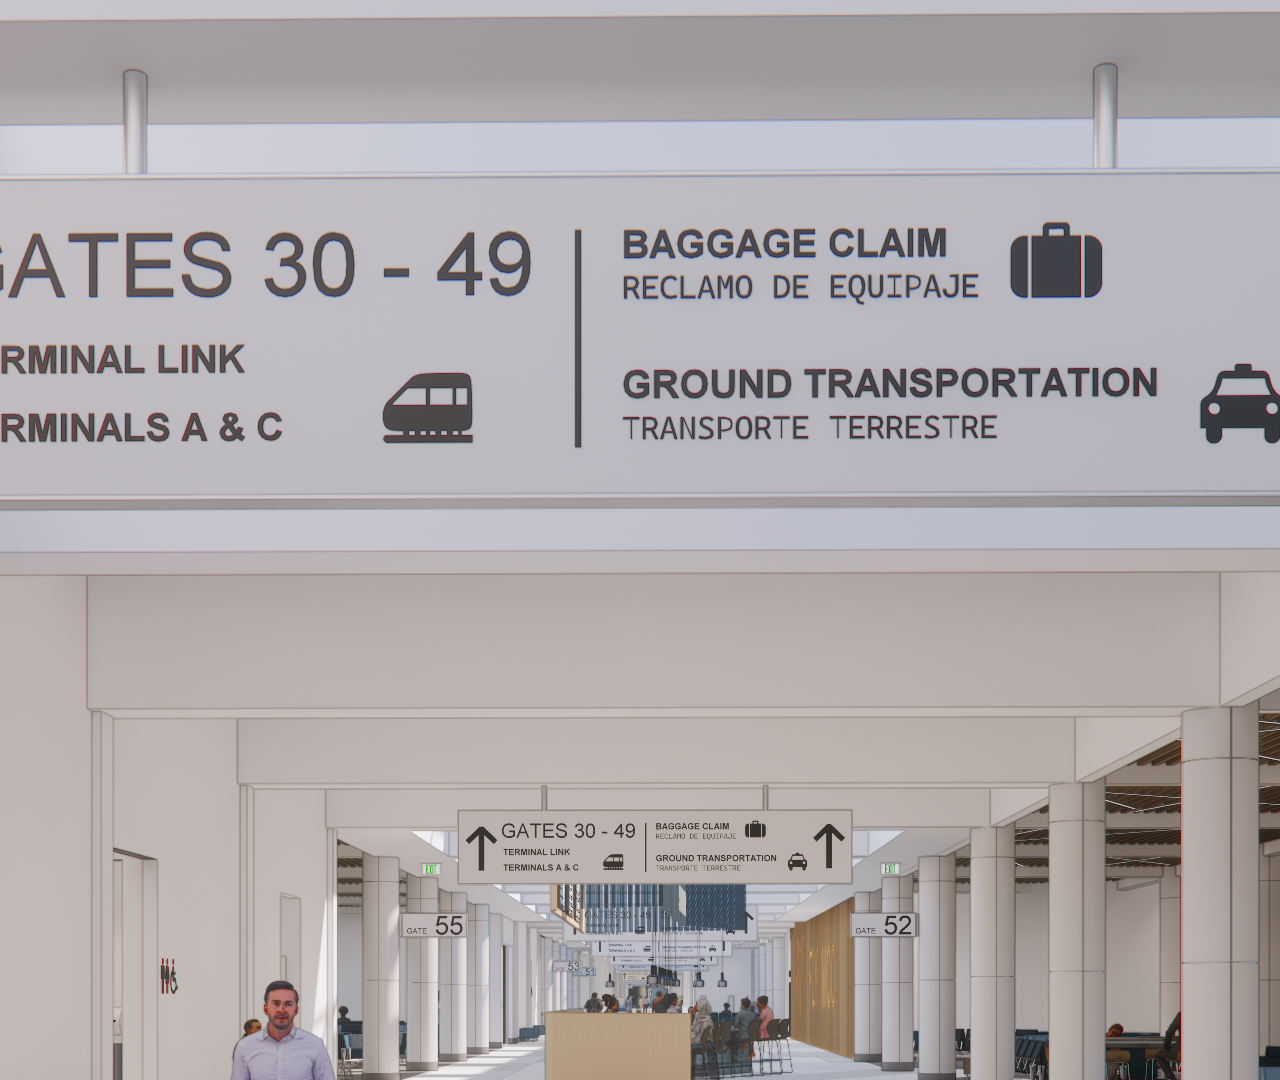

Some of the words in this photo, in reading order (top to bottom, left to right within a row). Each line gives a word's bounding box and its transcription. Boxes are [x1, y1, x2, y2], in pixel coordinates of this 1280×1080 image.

[623, 227, 816, 260] BAGGAGE
[828, 227, 947, 259] CLAIM
[264, 231, 355, 298] 30
[384, 267, 410, 278] -
[437, 231, 532, 297] 49
[623, 274, 753, 300] RECLAMO
[773, 274, 809, 299] DE
[830, 273, 979, 306] EQUIPAJE
[157, 343, 245, 374] LINK
[622, 368, 792, 400] GROUND
[803, 366, 1158, 399] TRANSPORTATION
[181, 413, 208, 442] A
[219, 412, 245, 443] &
[257, 412, 283, 442] C
[623, 415, 809, 441] TRANSPORTE
[829, 414, 998, 440] TERRESTRE
[501, 823, 568, 839] GATES
[574, 823, 596, 839] 30
[613, 823, 636, 839] 49
[655, 822, 700, 831] BAGGAGE
[702, 822, 730, 830] CLAIM
[702, 833, 737, 841] EQUIPAJE
[503, 848, 548, 856] TERMINAL
[550, 848, 571, 856] LINK
[655, 854, 695, 862] GROUND
[696, 854, 777, 862] TRANSPORTATION
[425, 864, 437, 875] EXIT
[503, 863, 554, 872] TERMINALS
[556, 863, 562, 872] A
[564, 863, 571, 872] &
[572, 863, 579, 872] C
[884, 863, 896, 874] EXIT
[406, 927, 428, 935] GATE
[435, 915, 463, 935] 55
[855, 927, 876, 935] GATE
[884, 915, 912, 935] 52
[567, 961, 581, 971] 53
[584, 968, 595, 976] 51
